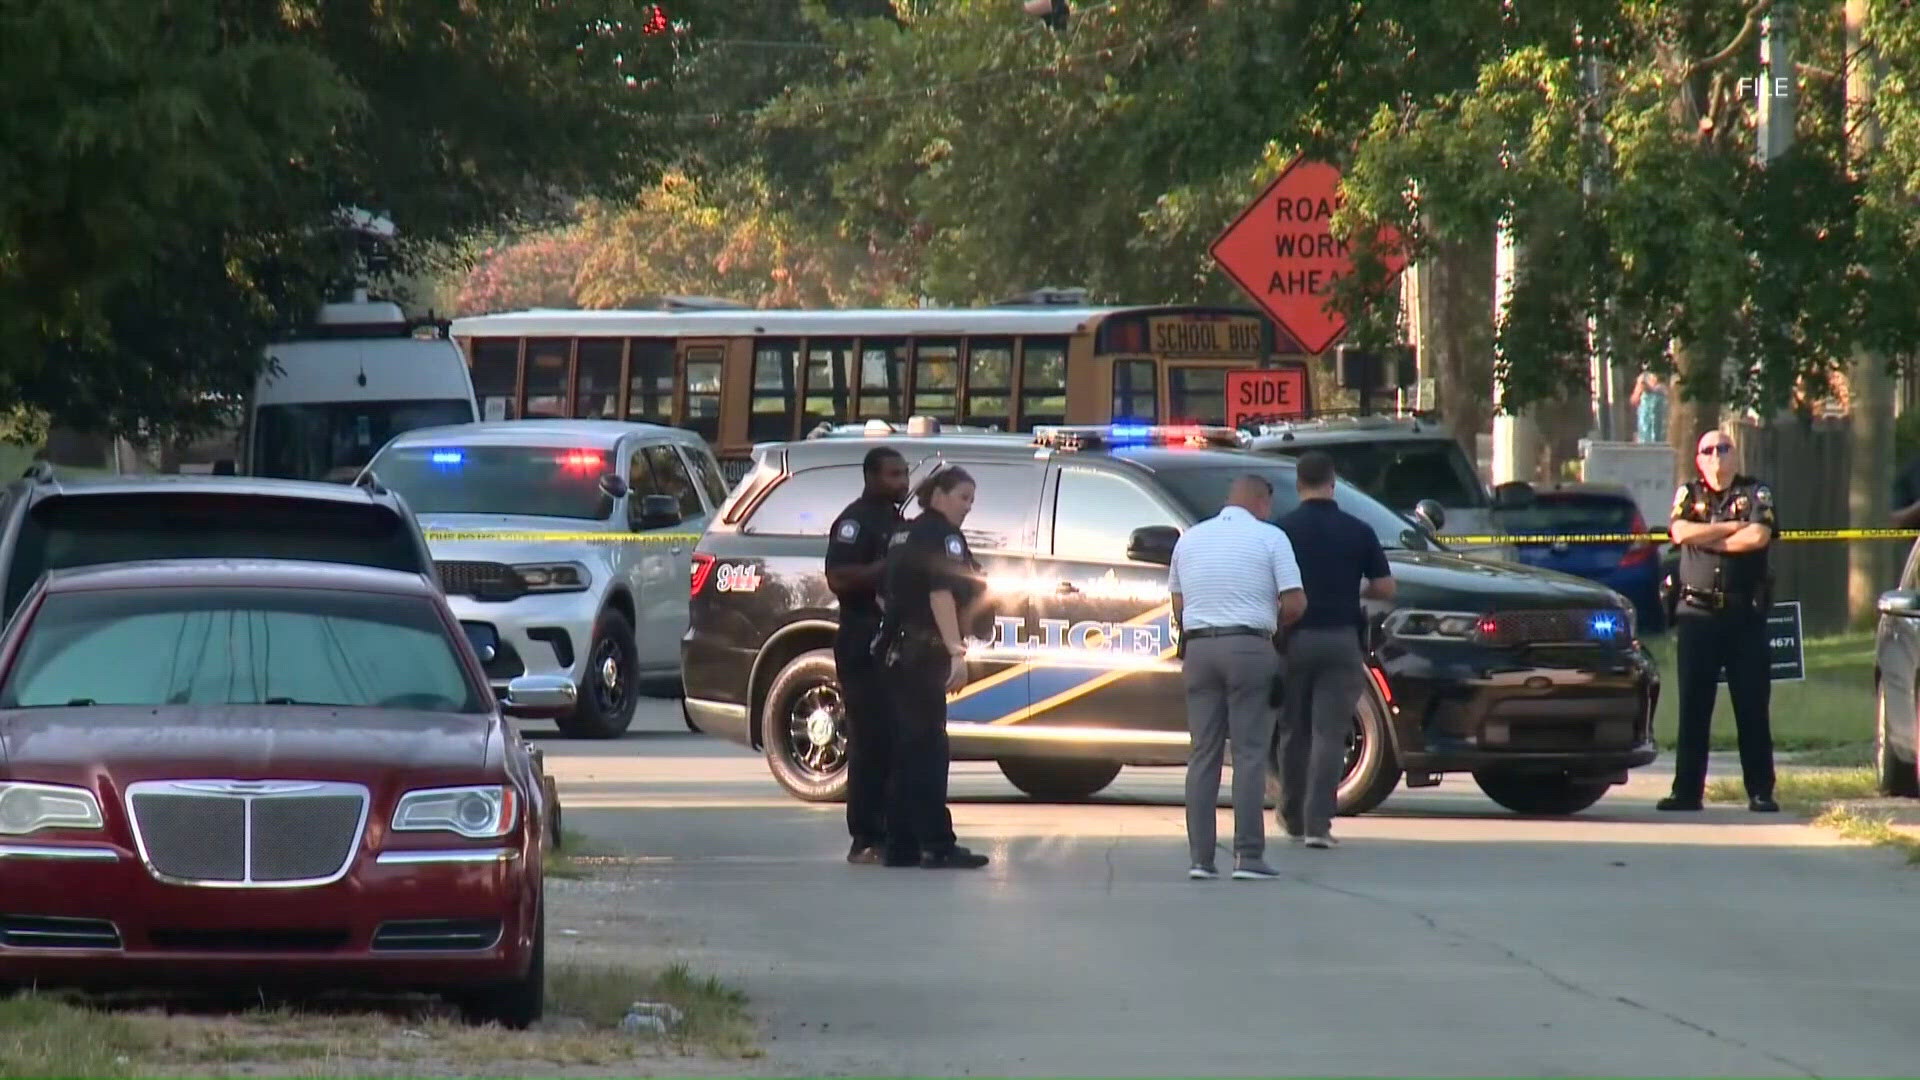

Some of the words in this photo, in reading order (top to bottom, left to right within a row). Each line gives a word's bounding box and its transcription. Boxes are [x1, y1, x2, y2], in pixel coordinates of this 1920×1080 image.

[1156, 322, 1222, 349] SCHOOL
[1229, 323, 1260, 350] BUS
[1239, 380, 1290, 406] SIDE
[717, 563, 757, 593] 911
[966, 615, 1161, 657] LICE
[1769, 637, 1795, 647] 4671
